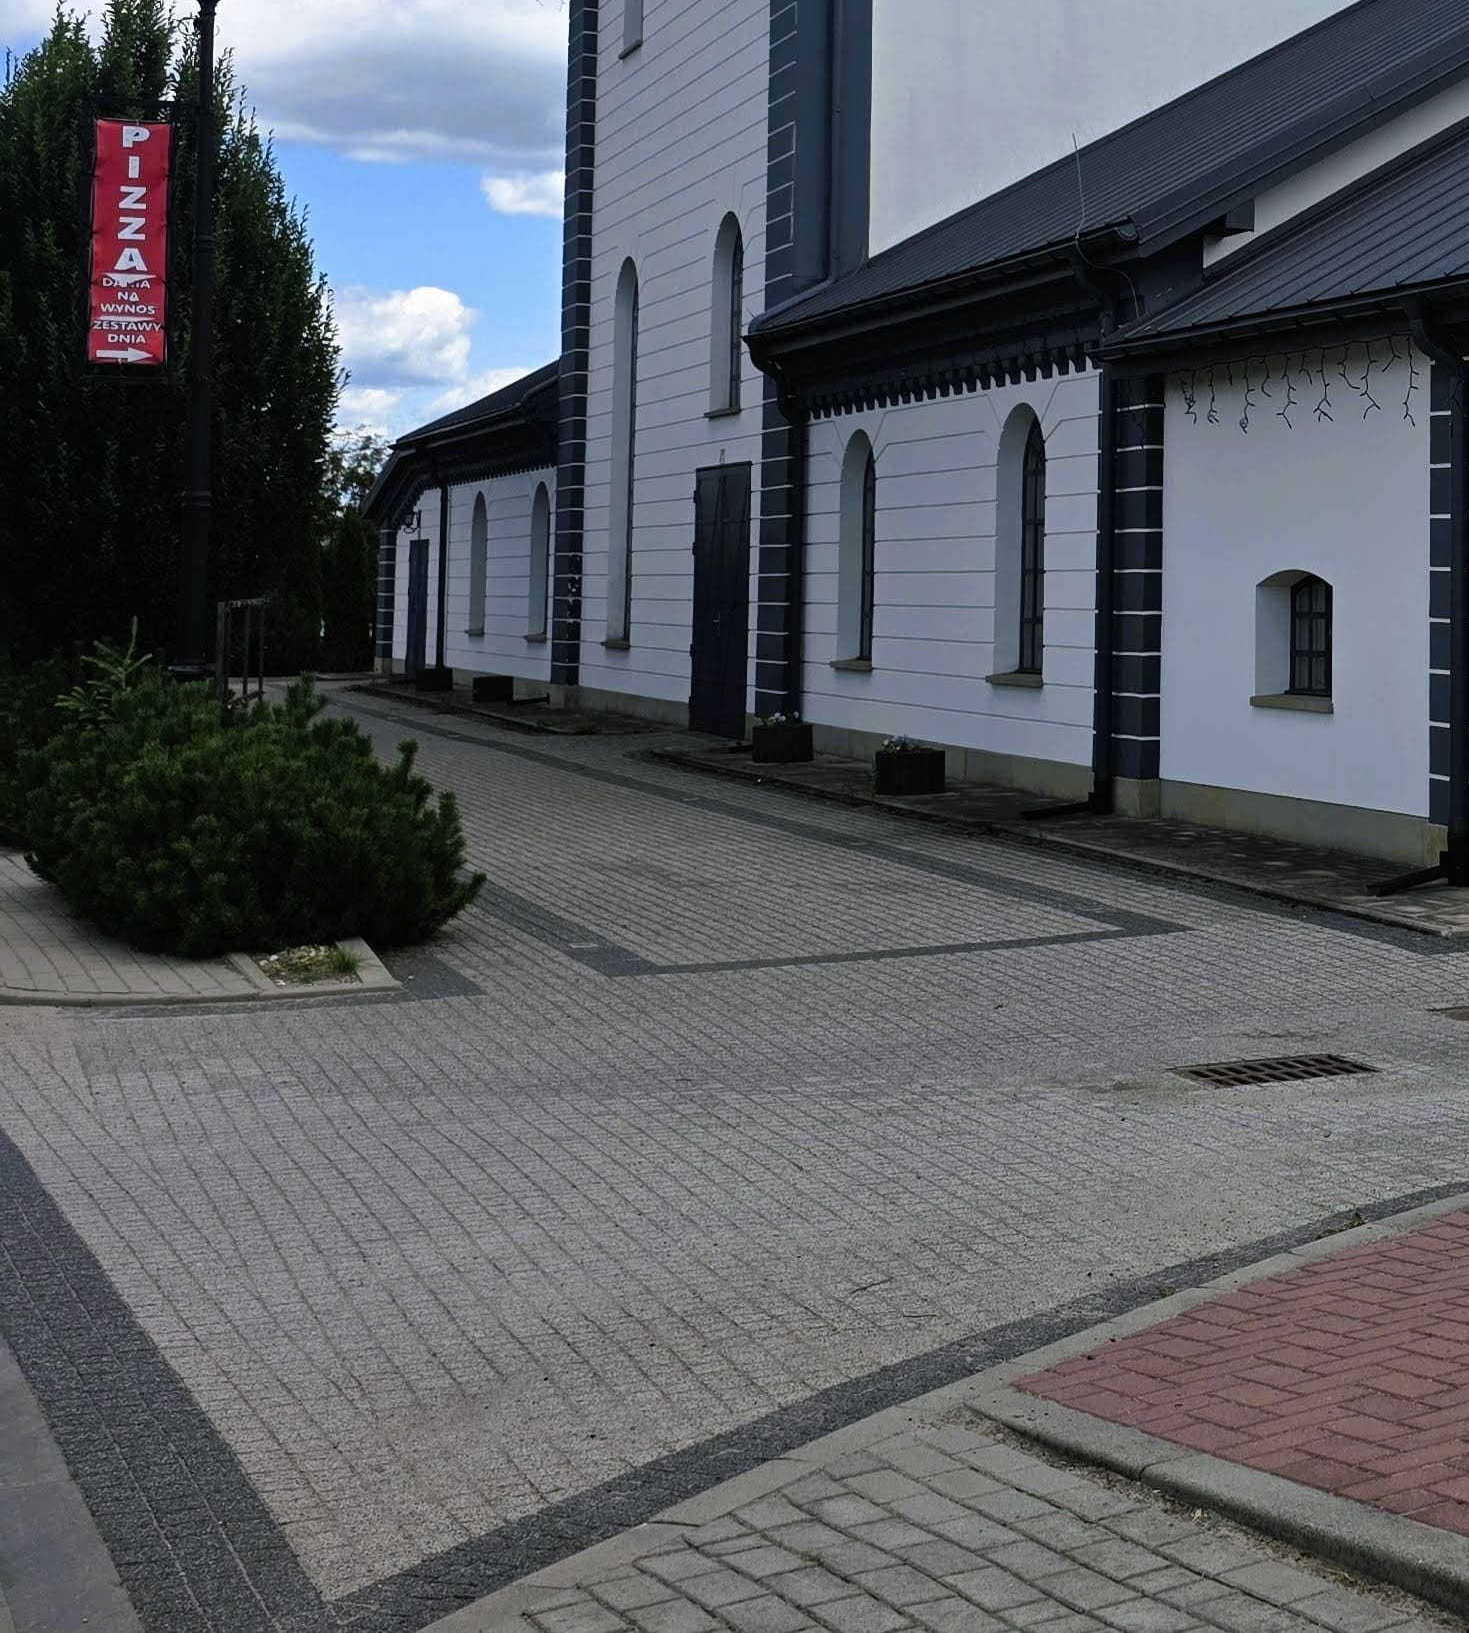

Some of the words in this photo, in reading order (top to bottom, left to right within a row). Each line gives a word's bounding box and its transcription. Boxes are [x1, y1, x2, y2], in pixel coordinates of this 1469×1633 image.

[113, 125, 151, 272] PIZZA
[117, 291, 140, 303] NA
[100, 303, 157, 315] WYNOS
[93, 320, 162, 332] ZESTAWY
[107, 333, 146, 344] DNIA
